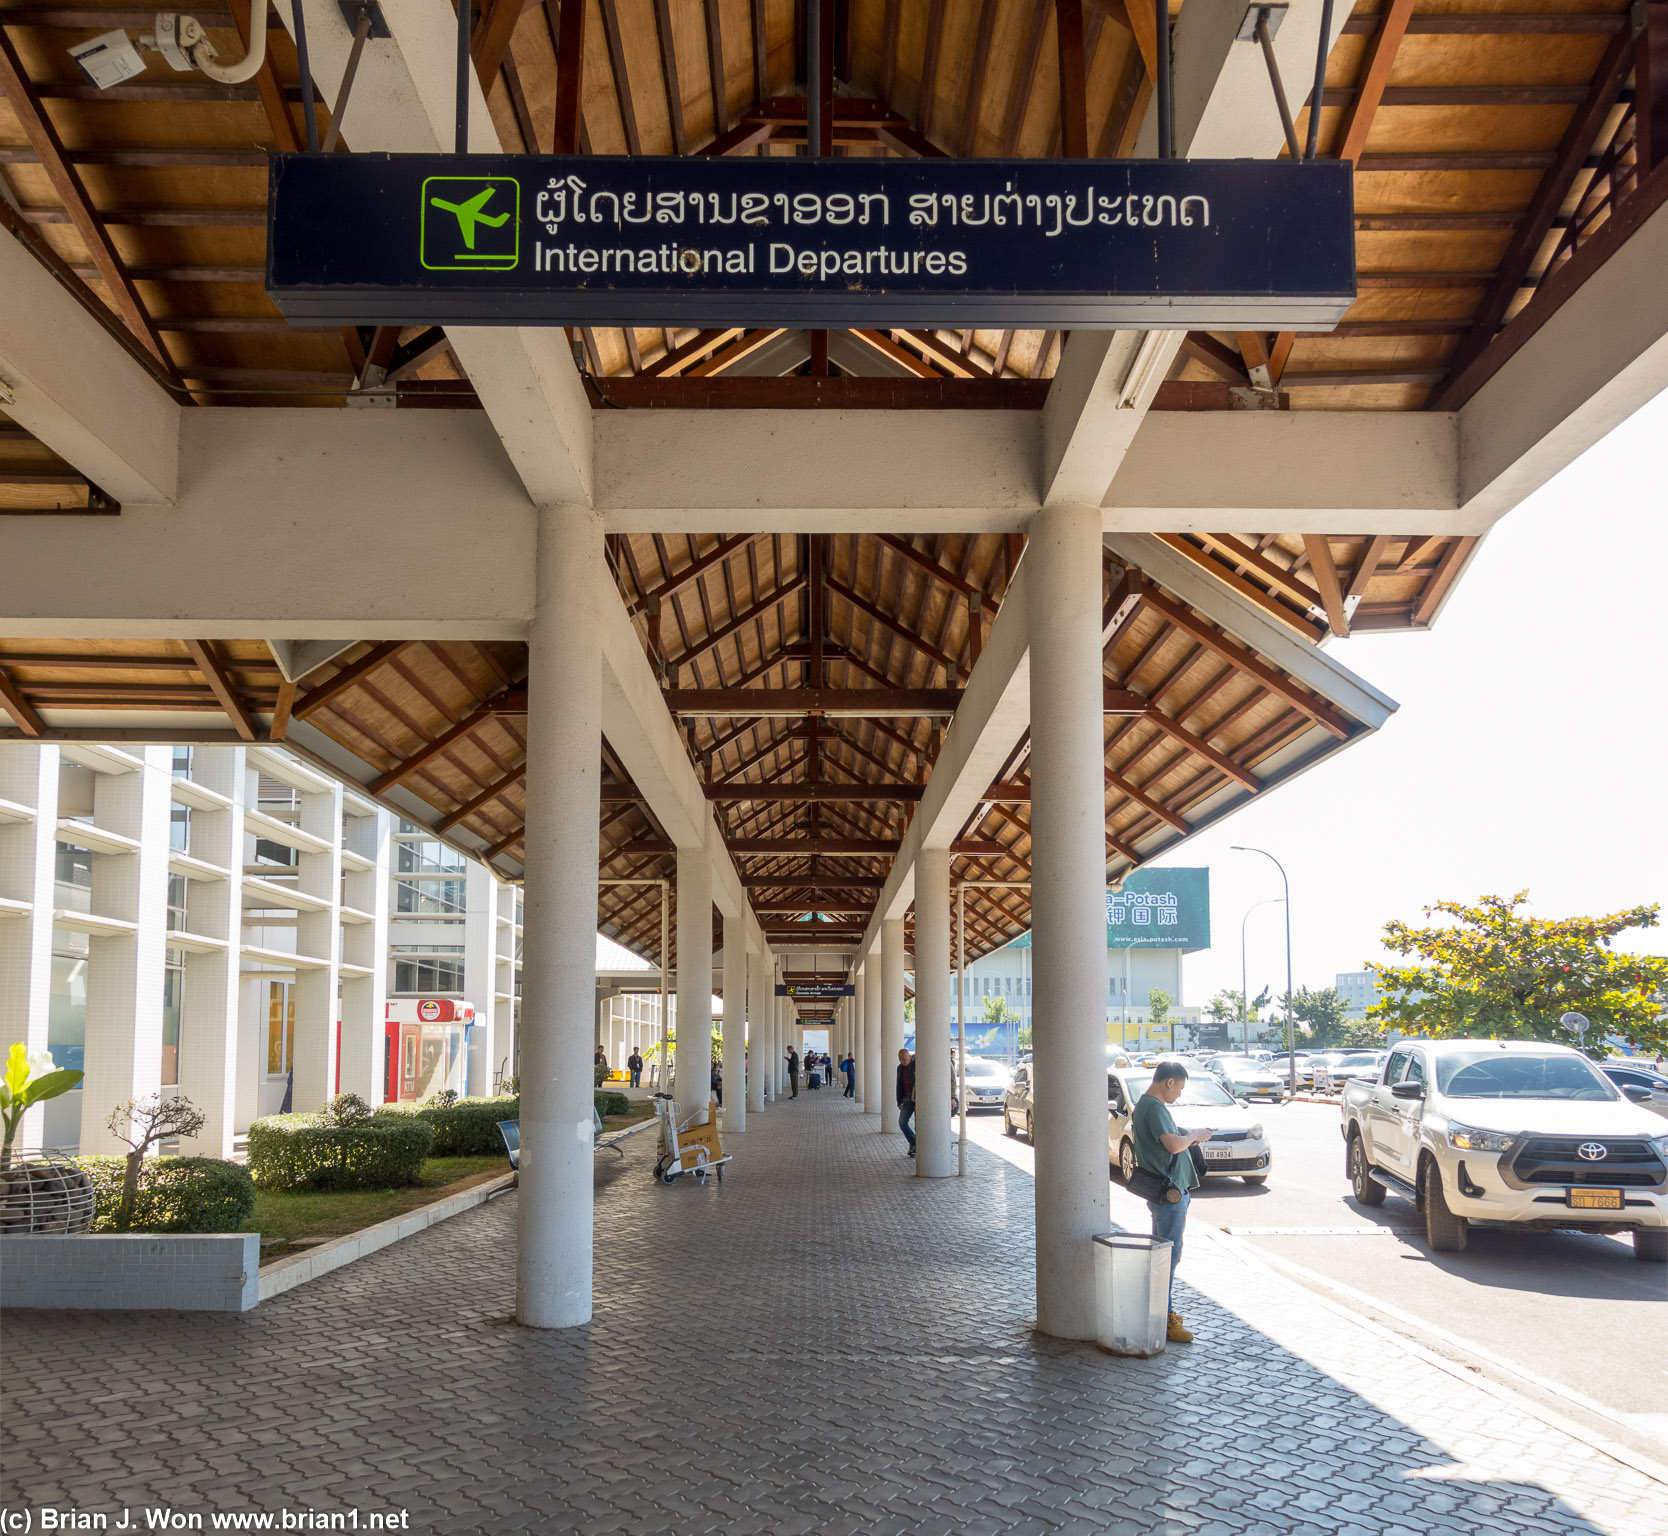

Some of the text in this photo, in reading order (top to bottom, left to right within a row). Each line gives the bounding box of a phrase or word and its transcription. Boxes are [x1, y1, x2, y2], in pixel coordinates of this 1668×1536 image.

[536, 175, 1210, 236] ຜູ້ໂດຍສານຂາອອກ ສາຍຕ່າງປະເທດ
[535, 241, 967, 281] International Departures
[1592, 1197, 1618, 1208] 7666
